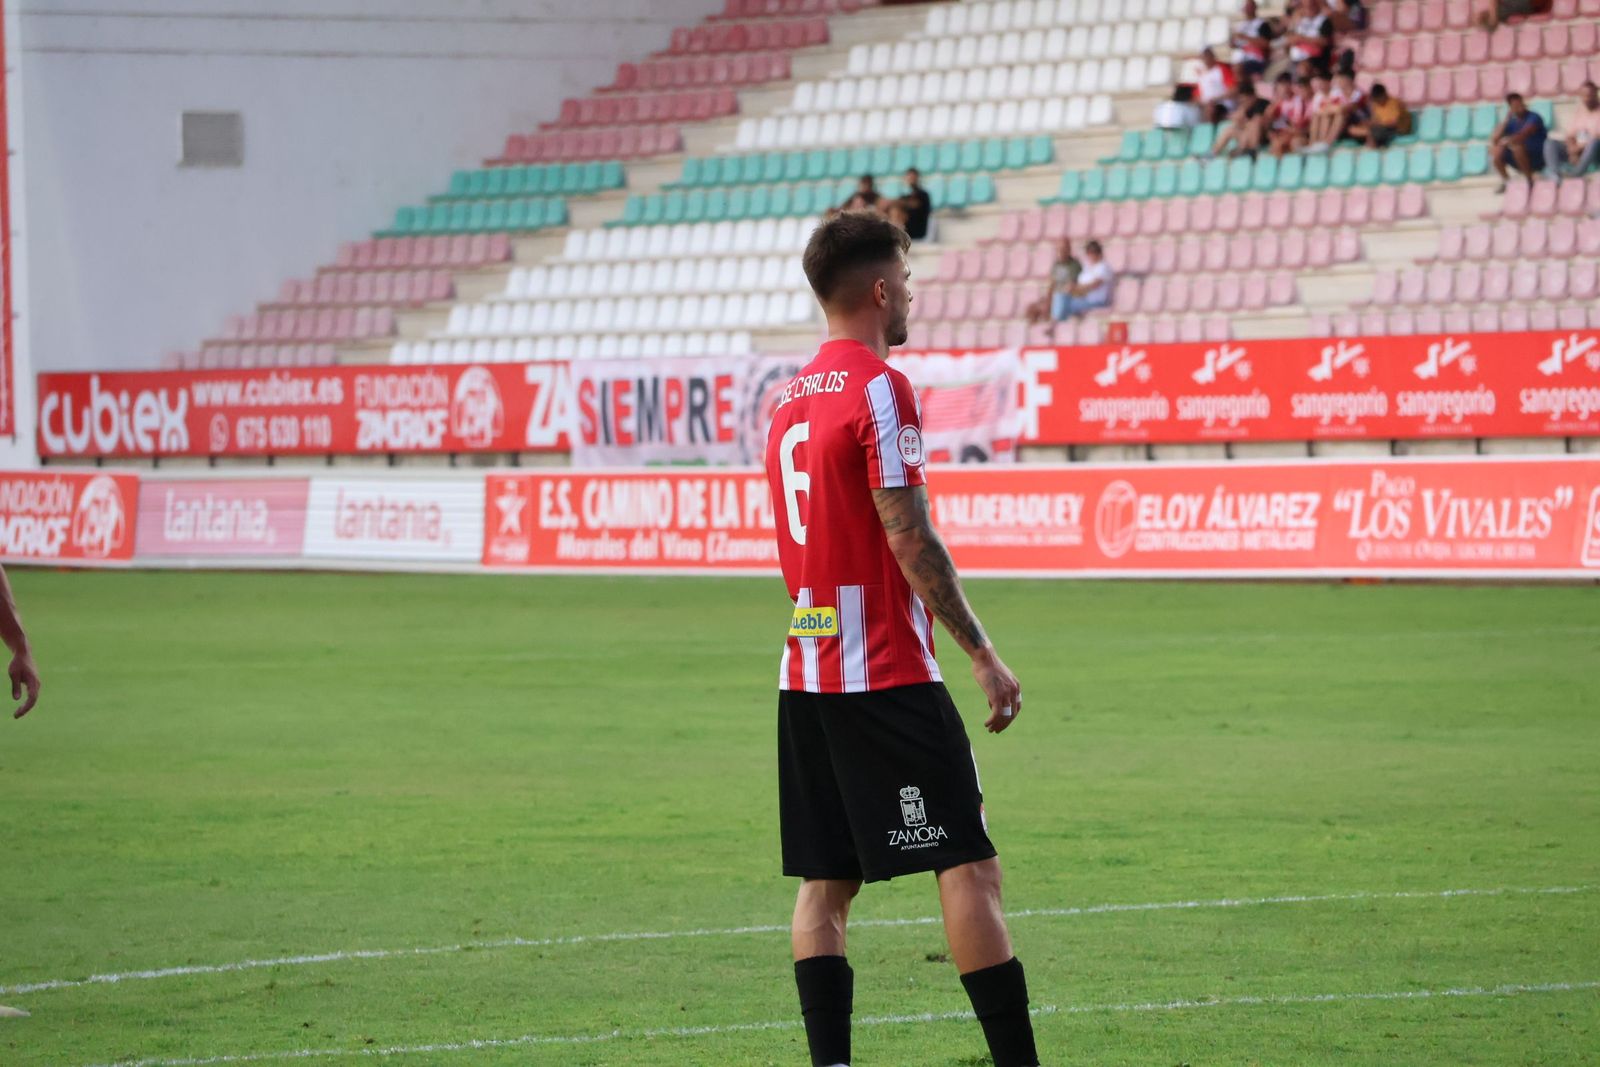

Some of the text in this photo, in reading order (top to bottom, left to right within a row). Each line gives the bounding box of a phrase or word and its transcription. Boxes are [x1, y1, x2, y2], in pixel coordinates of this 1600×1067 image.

[192, 373, 344, 408] www.cubiex.es
[355, 369, 449, 408] FUNDACIÓN
[794, 370, 849, 399] CARLOS
[41, 375, 189, 453] cubiex
[578, 374, 735, 448] SIEMPRE
[236, 414, 332, 450] 675 630 110
[904, 435, 917, 446] RF
[904, 447, 917, 456] EF
[779, 420, 811, 546] 6
[538, 479, 579, 529] E.S.
[582, 479, 674, 529] CAMINO
[677, 479, 707, 529] DE
[710, 479, 741, 529] LA
[1138, 484, 1322, 529] ELOY ÁLVAREZ
[630, 529, 659, 560] del
[887, 825, 948, 847] ZAMORA
[900, 840, 939, 851] AYUNTAMIENTO
